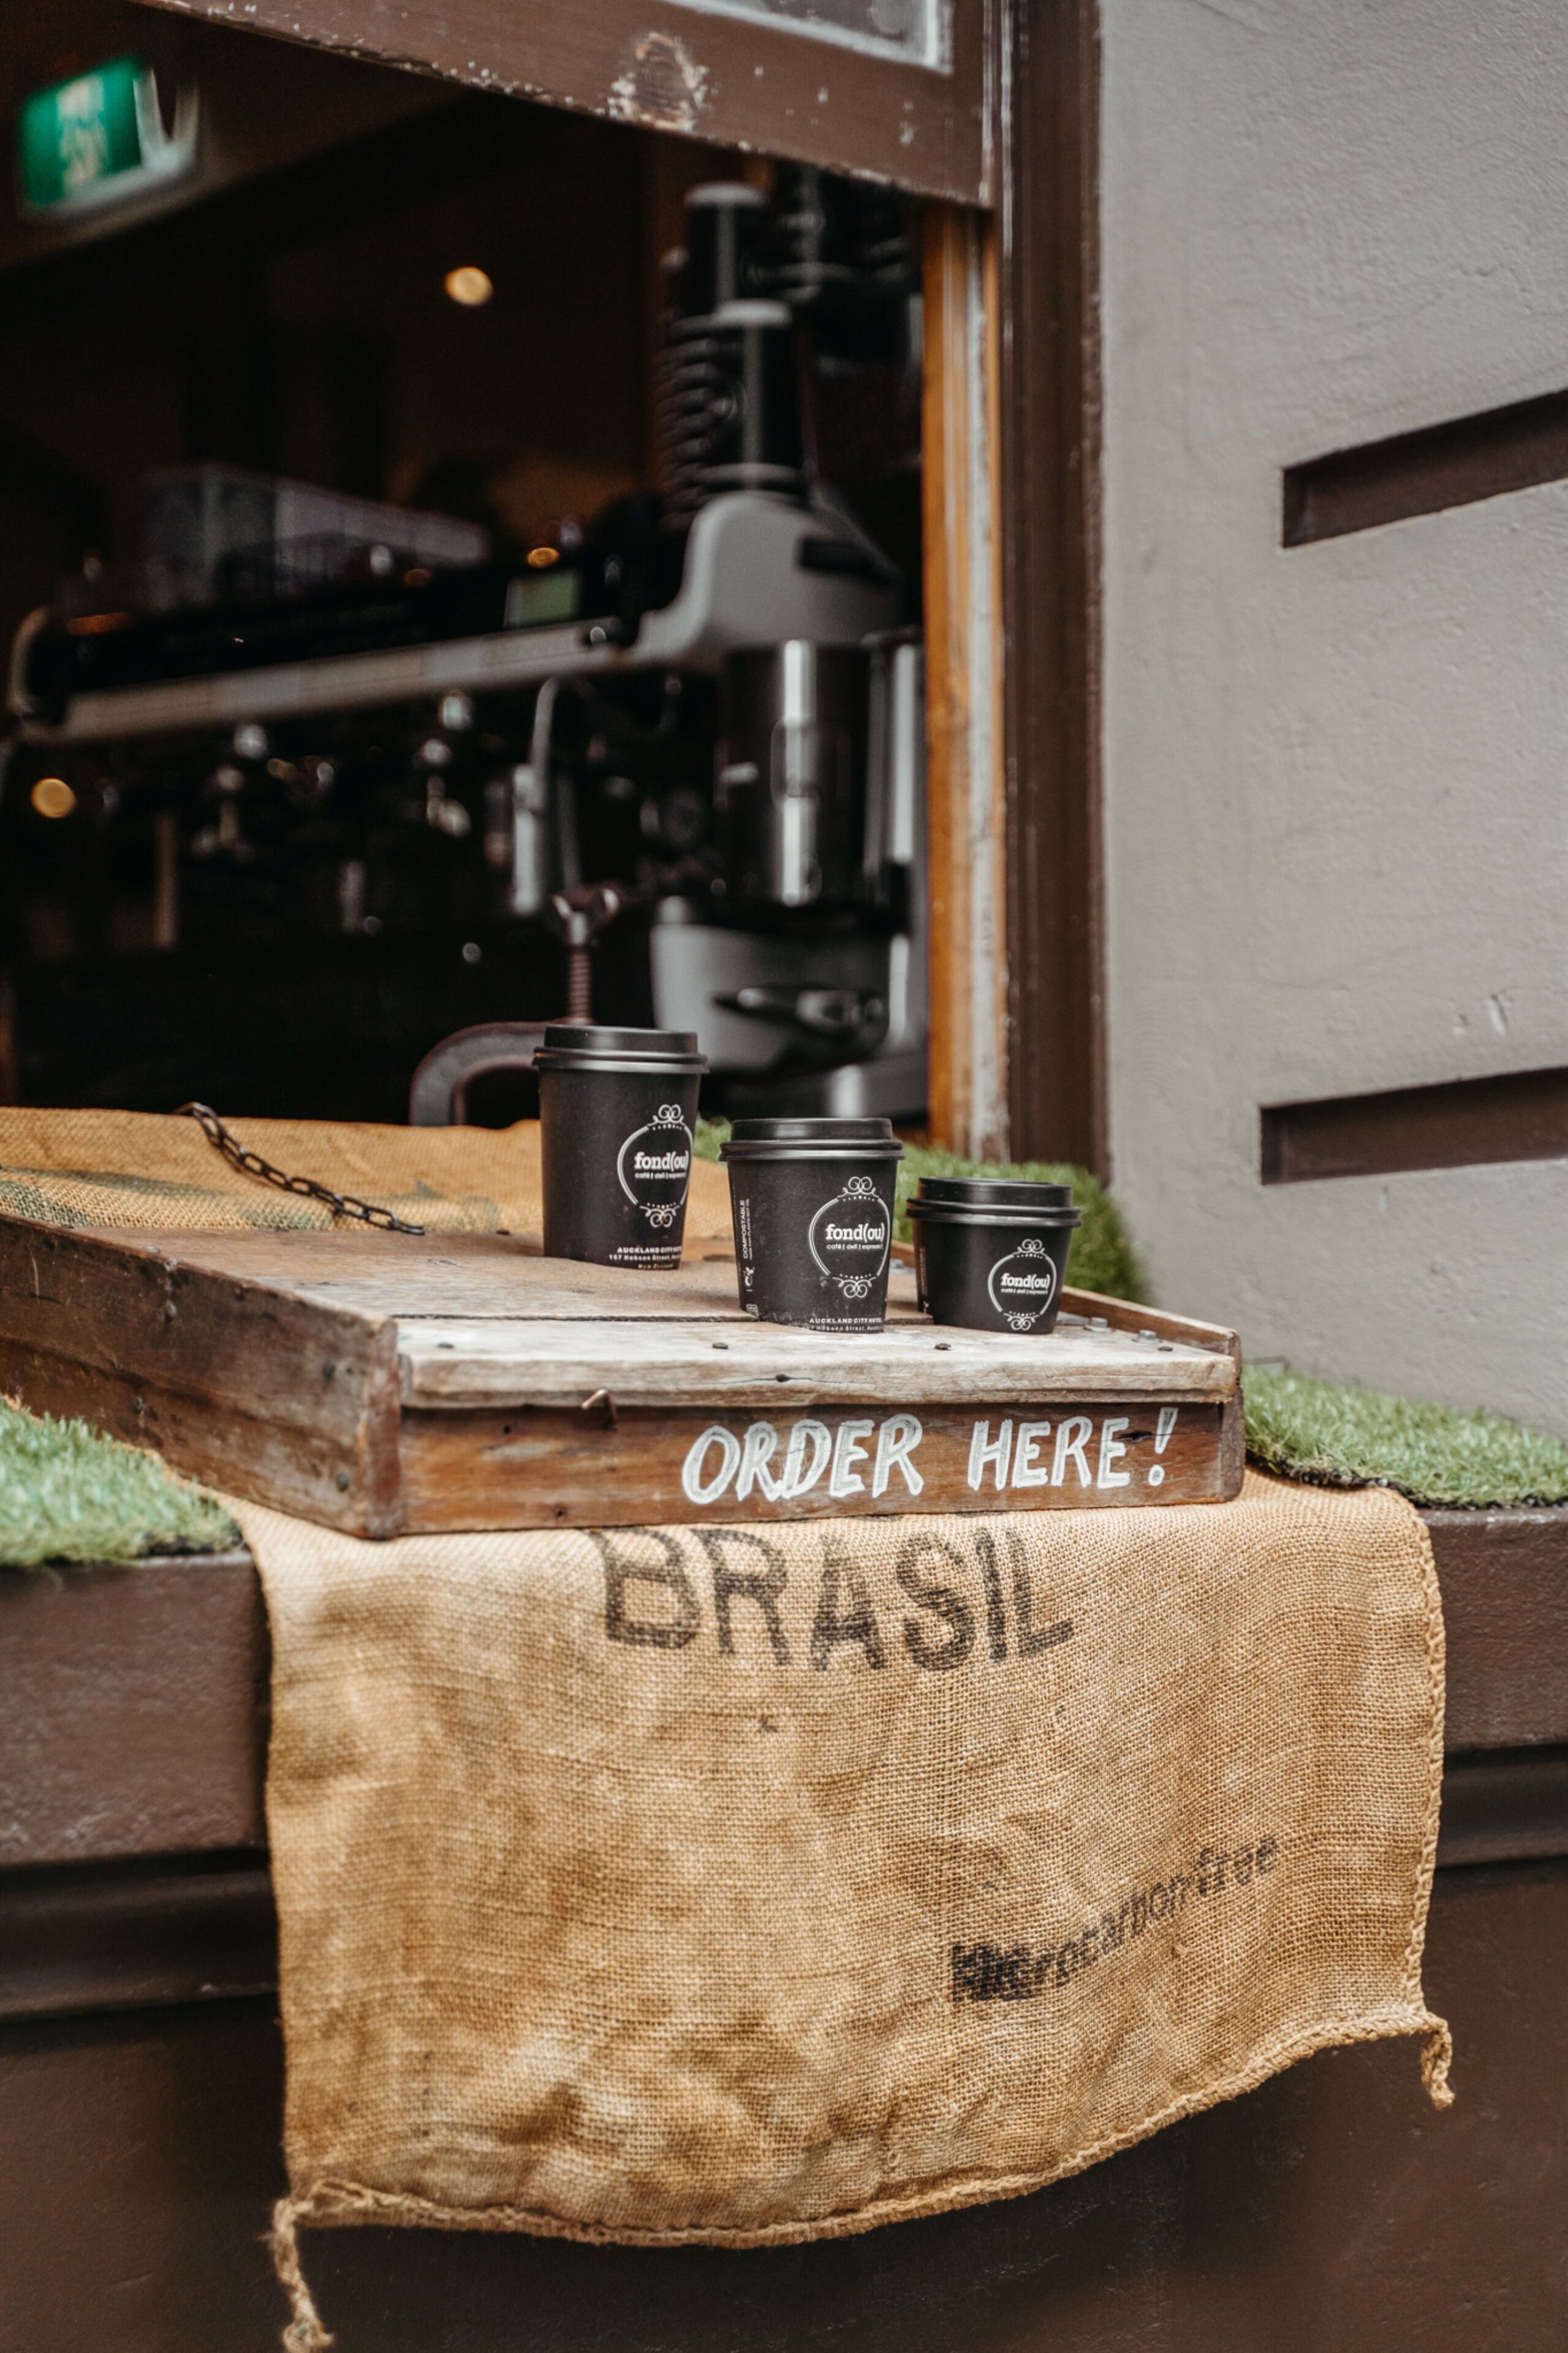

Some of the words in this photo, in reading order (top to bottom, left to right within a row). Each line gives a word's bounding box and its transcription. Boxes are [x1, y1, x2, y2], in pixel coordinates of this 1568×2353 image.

[634, 1150, 689, 1172] fond(ou)
[825, 1223, 884, 1243] fond(ou)
[1001, 1273, 1051, 1289] fond(ou)
[683, 1412, 924, 1505] ORDER
[591, 1526, 1075, 1673] BRASIL
